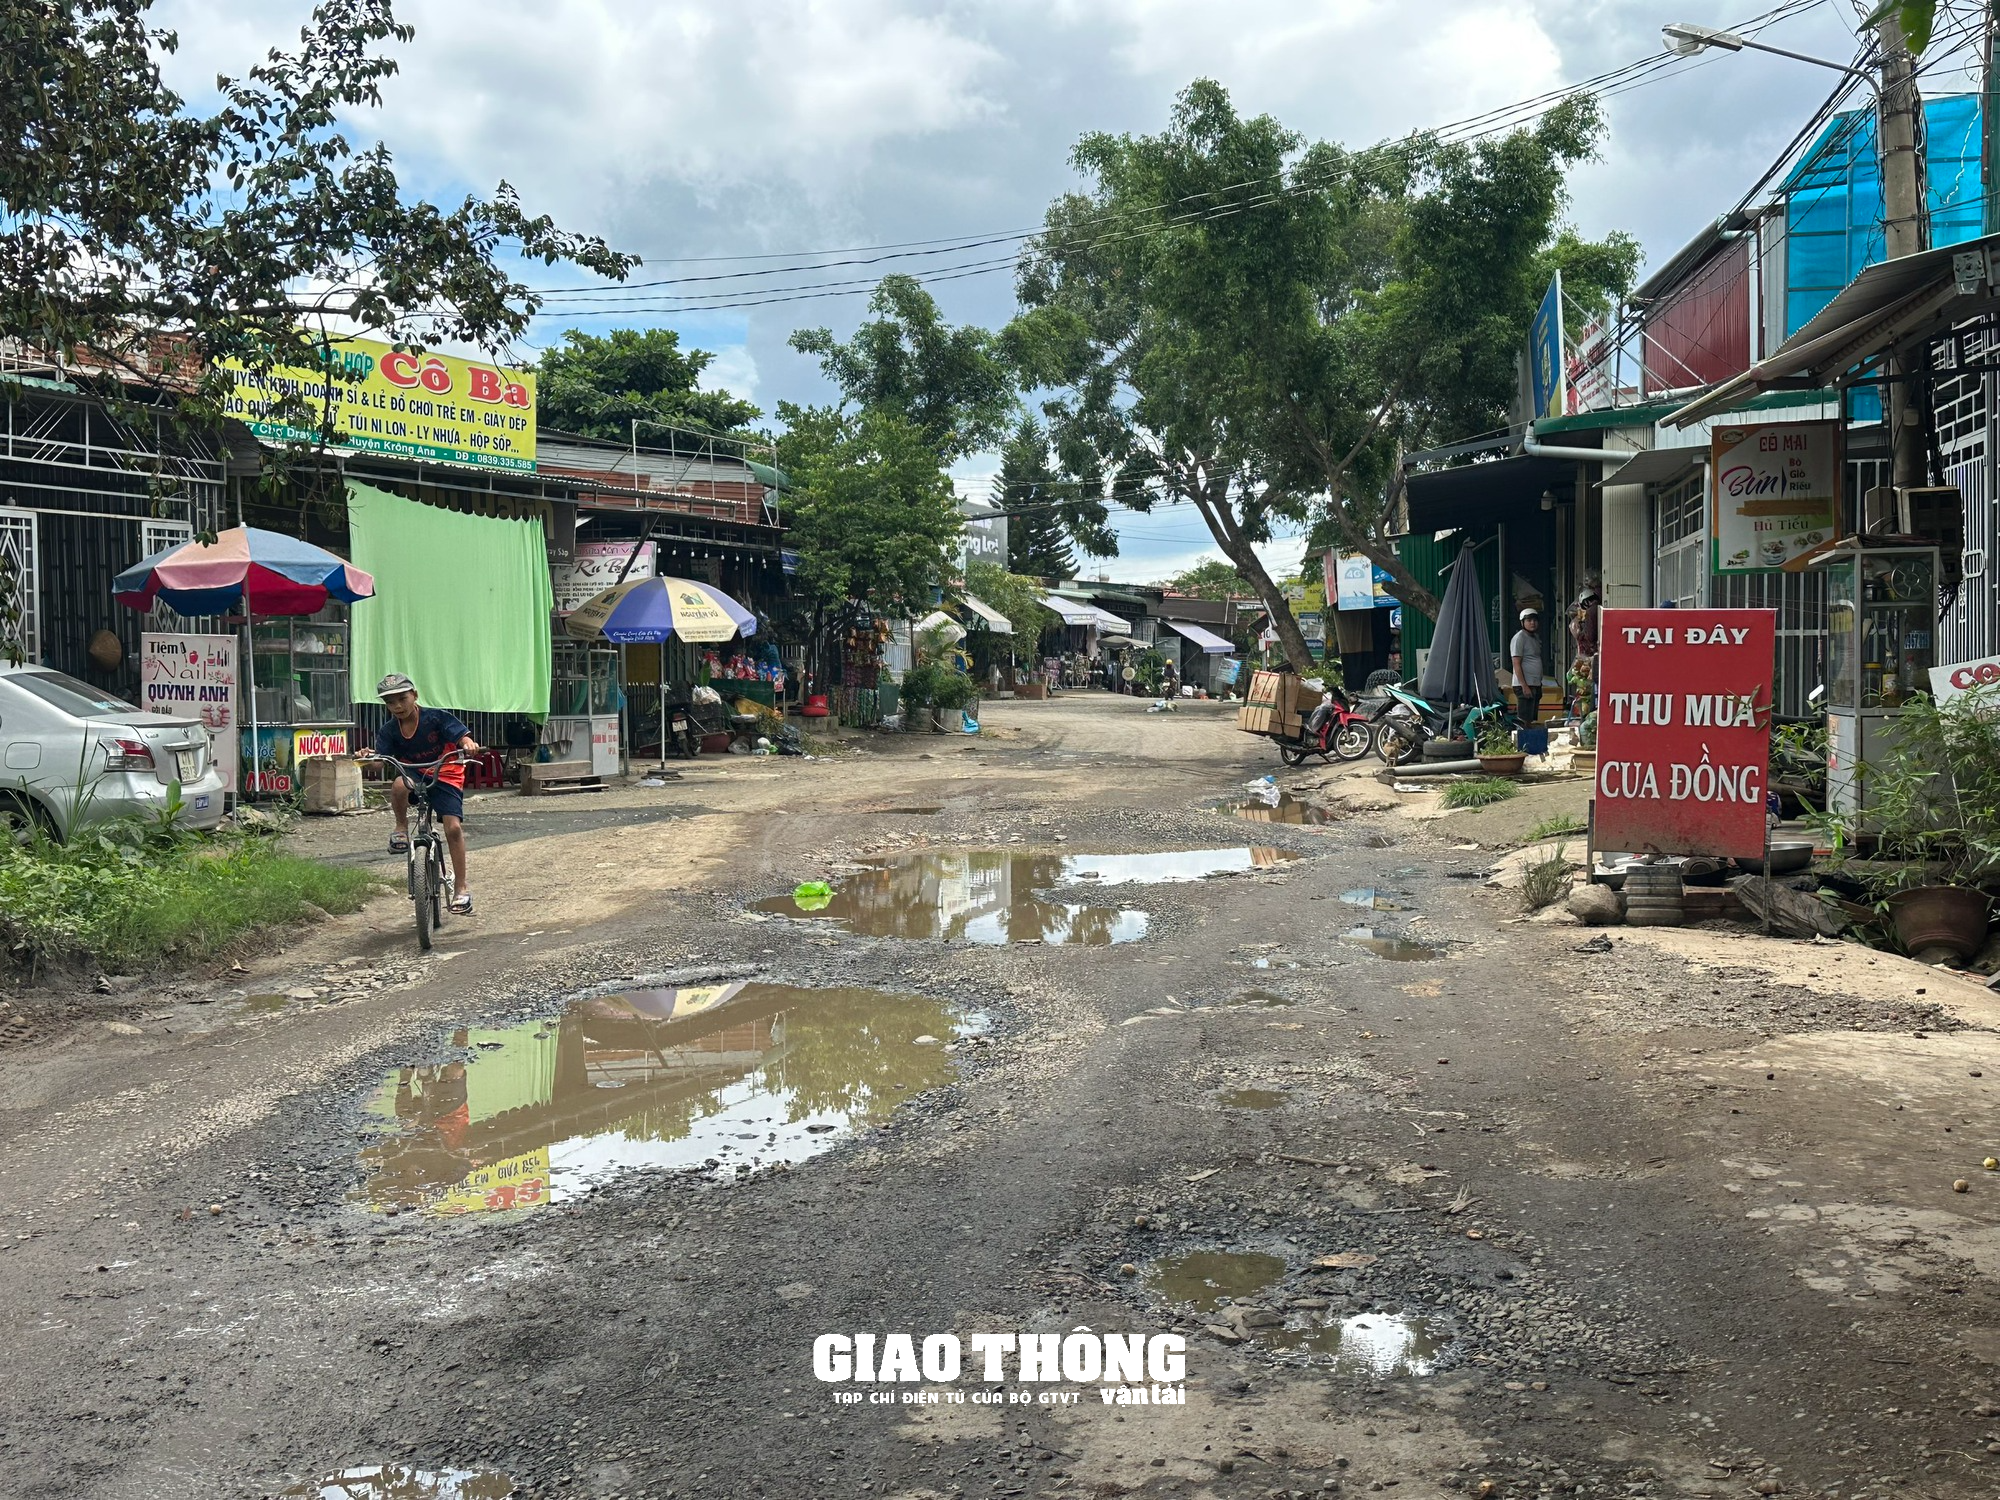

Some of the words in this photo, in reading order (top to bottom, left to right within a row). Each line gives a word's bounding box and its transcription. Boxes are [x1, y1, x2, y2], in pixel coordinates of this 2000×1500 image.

[380, 351, 453, 395] Cô
[467, 366, 531, 410] Ba
[304, 382, 343, 402] DOANH
[347, 385, 357, 404] SỈ
[361, 391, 369, 406] &
[373, 389, 386, 409] LẺ
[391, 391, 405, 412] ĐỒ
[409, 400, 433, 417] CHƠI
[436, 401, 456, 420] TRẺ
[461, 408, 475, 423] EM
[484, 410, 506, 428] GIÀY
[509, 414, 527, 431] DÉP
[348, 412, 367, 431] TÚI
[371, 418, 382, 433] NI
[386, 421, 406, 436] LON
[417, 425, 429, 440] LY
[433, 428, 460, 446] NHỰA
[470, 431, 489, 450] HỘP
[1783, 434, 1807, 451] MAI
[349, 436, 380, 449] Huyện
[384, 440, 414, 456] Krông
[417, 445, 436, 457] Ana
[477, 454, 532, 469] 0839.335.585
[1721, 466, 1778, 497] Bún
[1346, 570, 1361, 578] 4G
[148, 641, 178, 657] Tiệm
[1621, 627, 1674, 649] TẠI
[1684, 623, 1749, 645] ĐÂY
[152, 659, 206, 680] Nail
[148, 681, 195, 702] QUỲNH
[199, 686, 229, 702] ANH
[1609, 692, 1673, 725] THU
[1684, 694, 1756, 727] MUA
[299, 731, 326, 755] NƯỚC
[328, 730, 345, 754] MÍA
[245, 769, 291, 792] Mía
[1600, 761, 1660, 799] CUA
[1669, 743, 1760, 803] ĐỒNG
